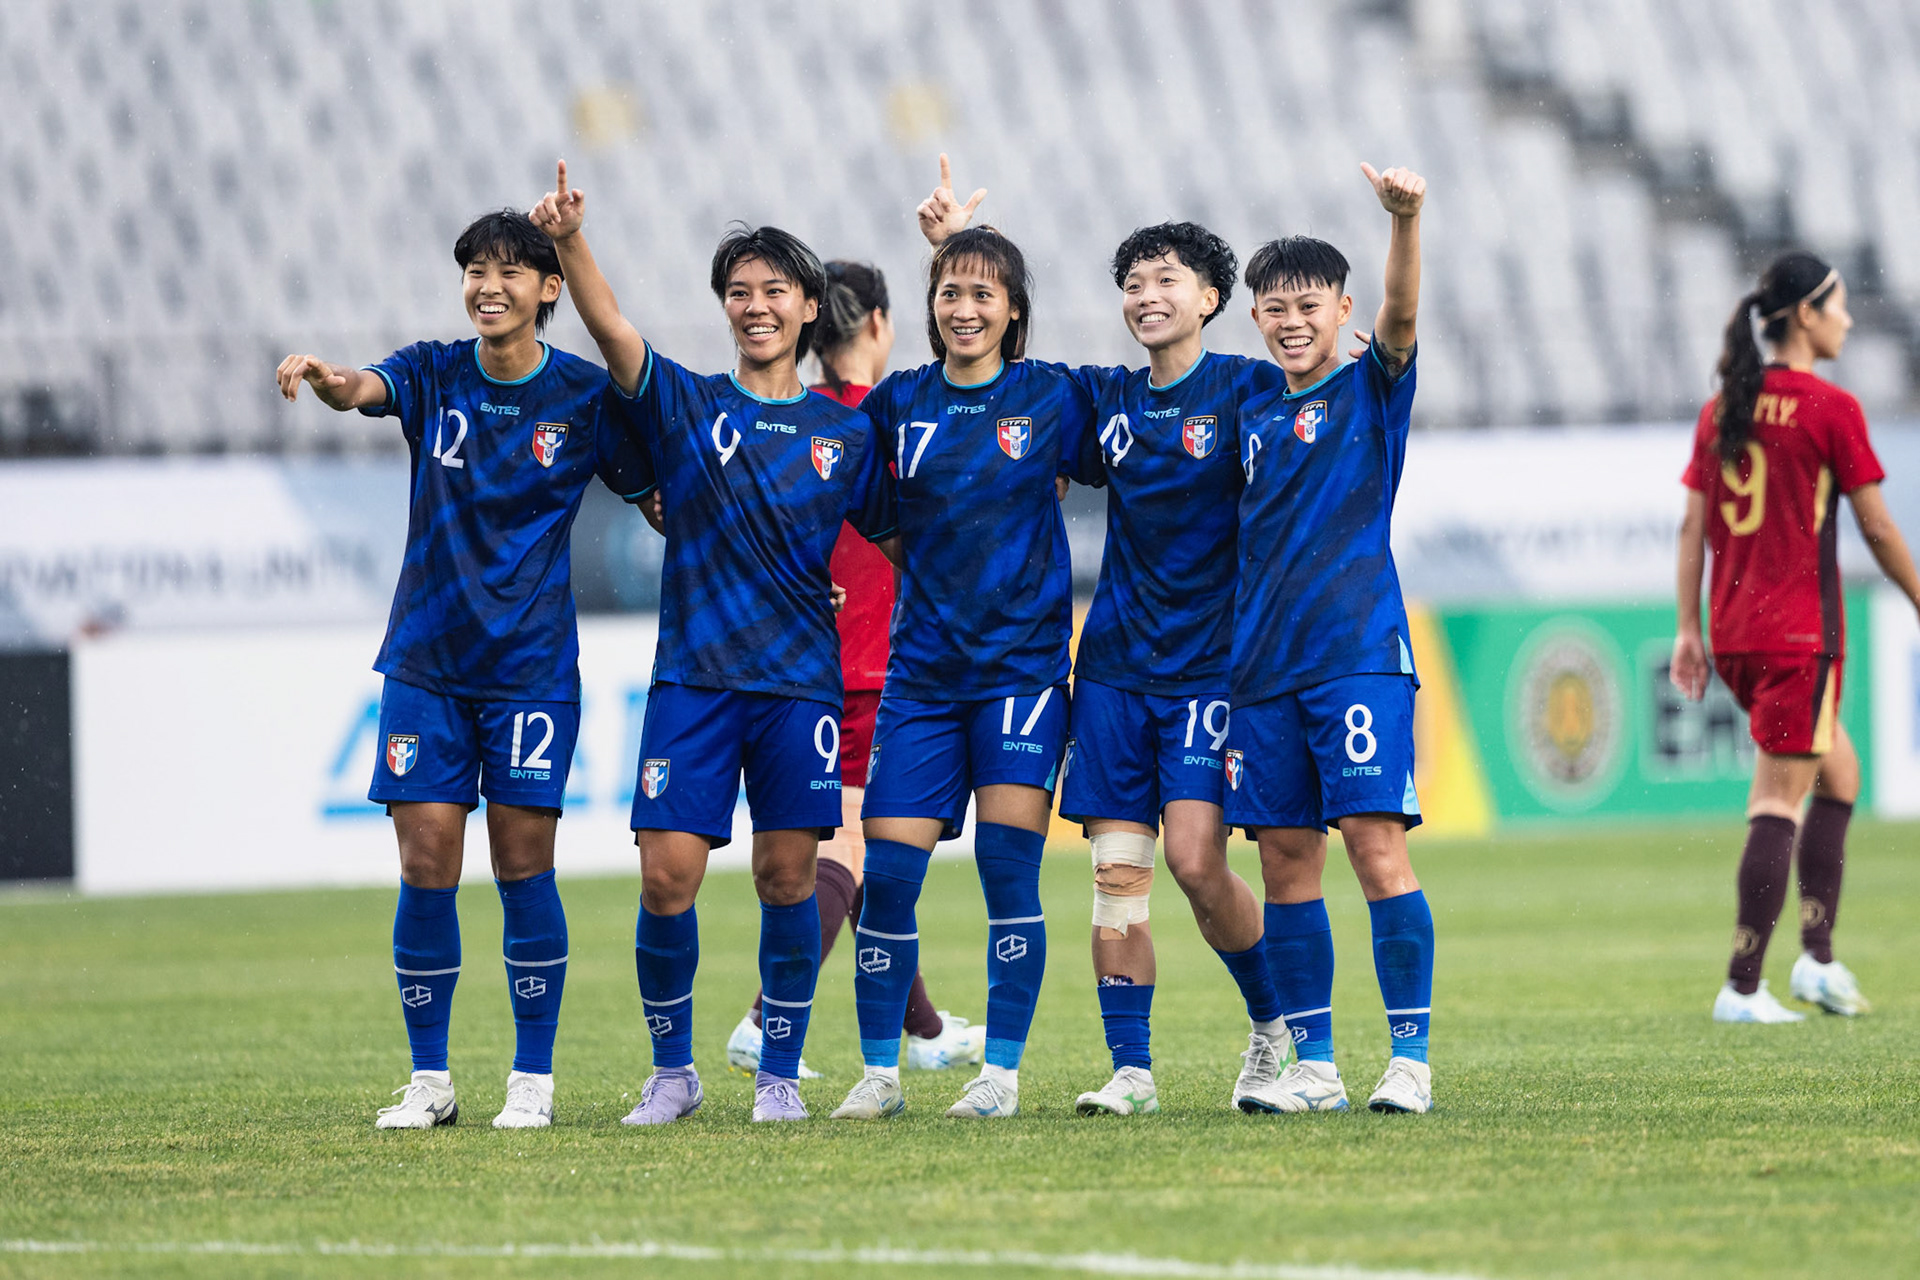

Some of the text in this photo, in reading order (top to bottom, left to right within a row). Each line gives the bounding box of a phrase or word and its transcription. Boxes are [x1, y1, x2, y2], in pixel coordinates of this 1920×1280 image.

[480, 402, 520, 416] ENTES
[947, 404, 986, 415] ENTES
[755, 421, 797, 434] ENTES
[1186, 418, 1215, 426] CTFA
[537, 425, 567, 433] CTFA
[433, 406, 468, 469] 12
[814, 439, 842, 450] CTFA
[897, 421, 939, 479] 17
[1720, 440, 1767, 536] 9
[1184, 699, 1230, 751] 19
[390, 736, 417, 744] CTFA
[510, 711, 555, 769] 12
[1344, 703, 1377, 764] 8
[813, 714, 840, 774] 9
[1002, 741, 1043, 754] ENTES
[1183, 755, 1223, 769] ENTES
[509, 769, 550, 780] ENTES
[1342, 765, 1382, 777] ENTES
